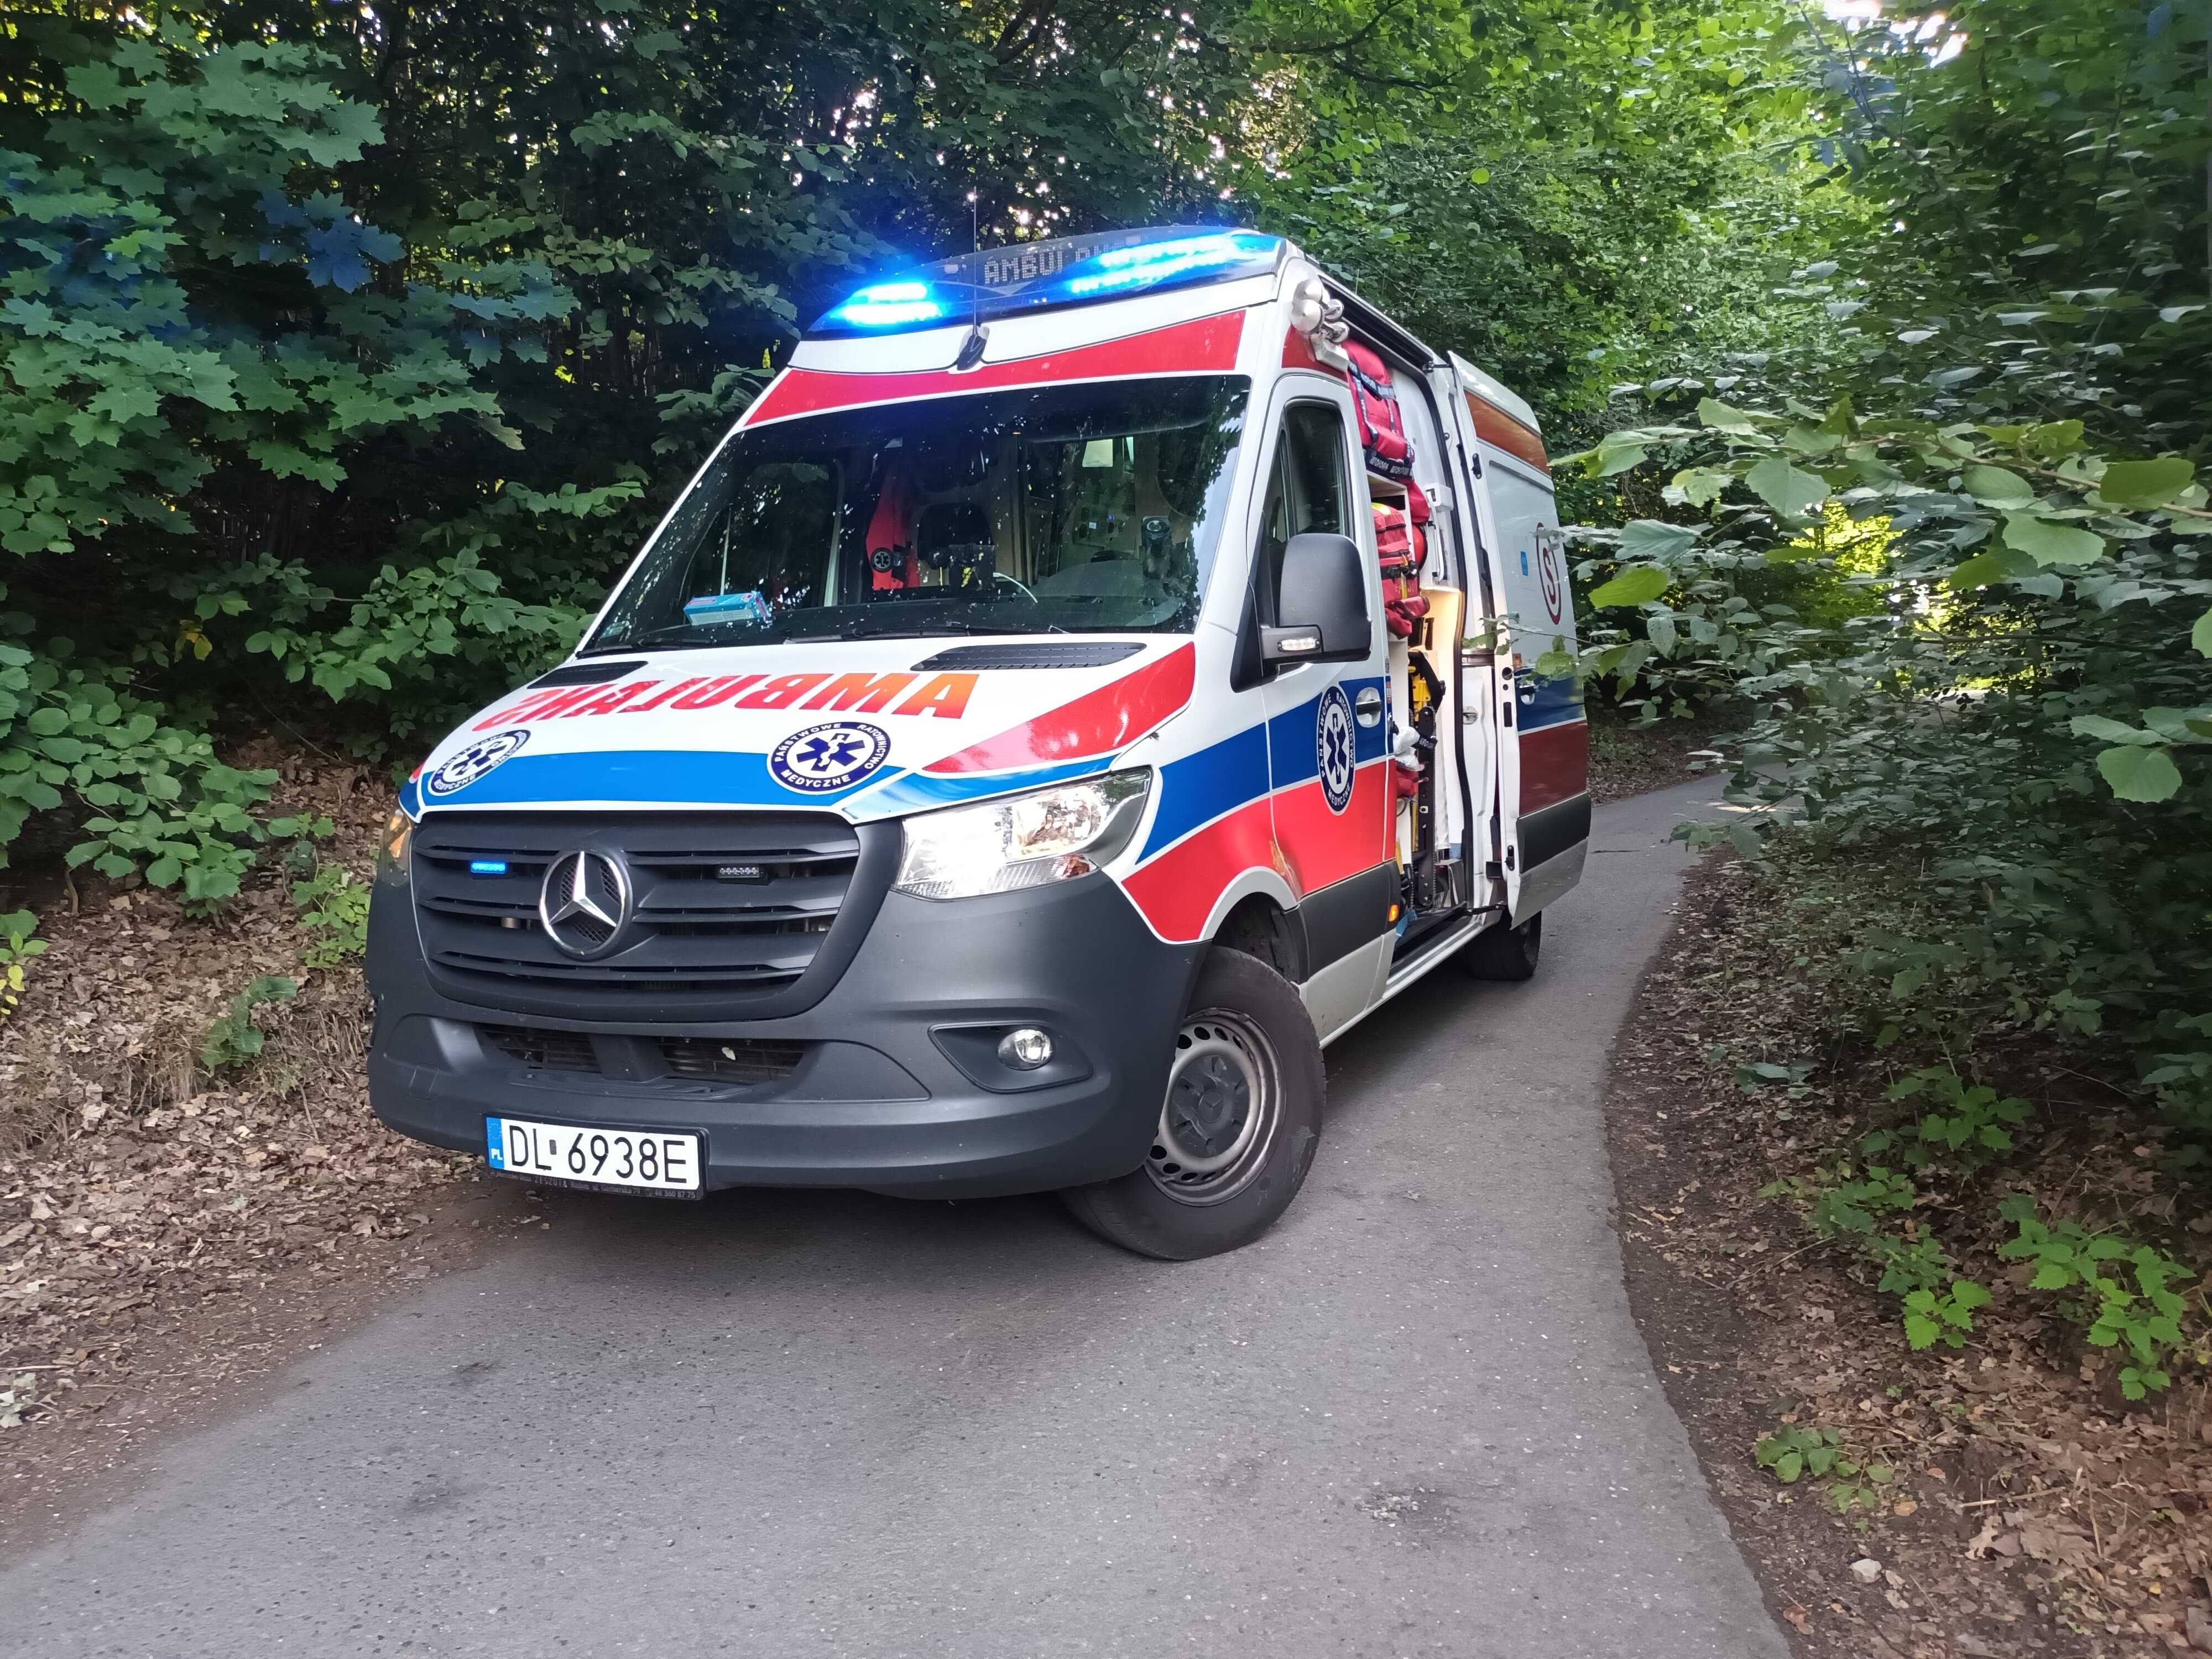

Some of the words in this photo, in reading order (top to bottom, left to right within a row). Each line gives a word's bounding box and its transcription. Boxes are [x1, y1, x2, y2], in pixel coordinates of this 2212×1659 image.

[857, 724, 888, 770] RATOWNICTWO
[1335, 692, 1354, 768] RATOWNICTWO
[780, 769, 852, 788] MEDYCZNE
[1328, 781, 1351, 807] MEDYCZNE
[491, 1147, 503, 1161] PL
[567, 1133, 687, 1183] 6938E
